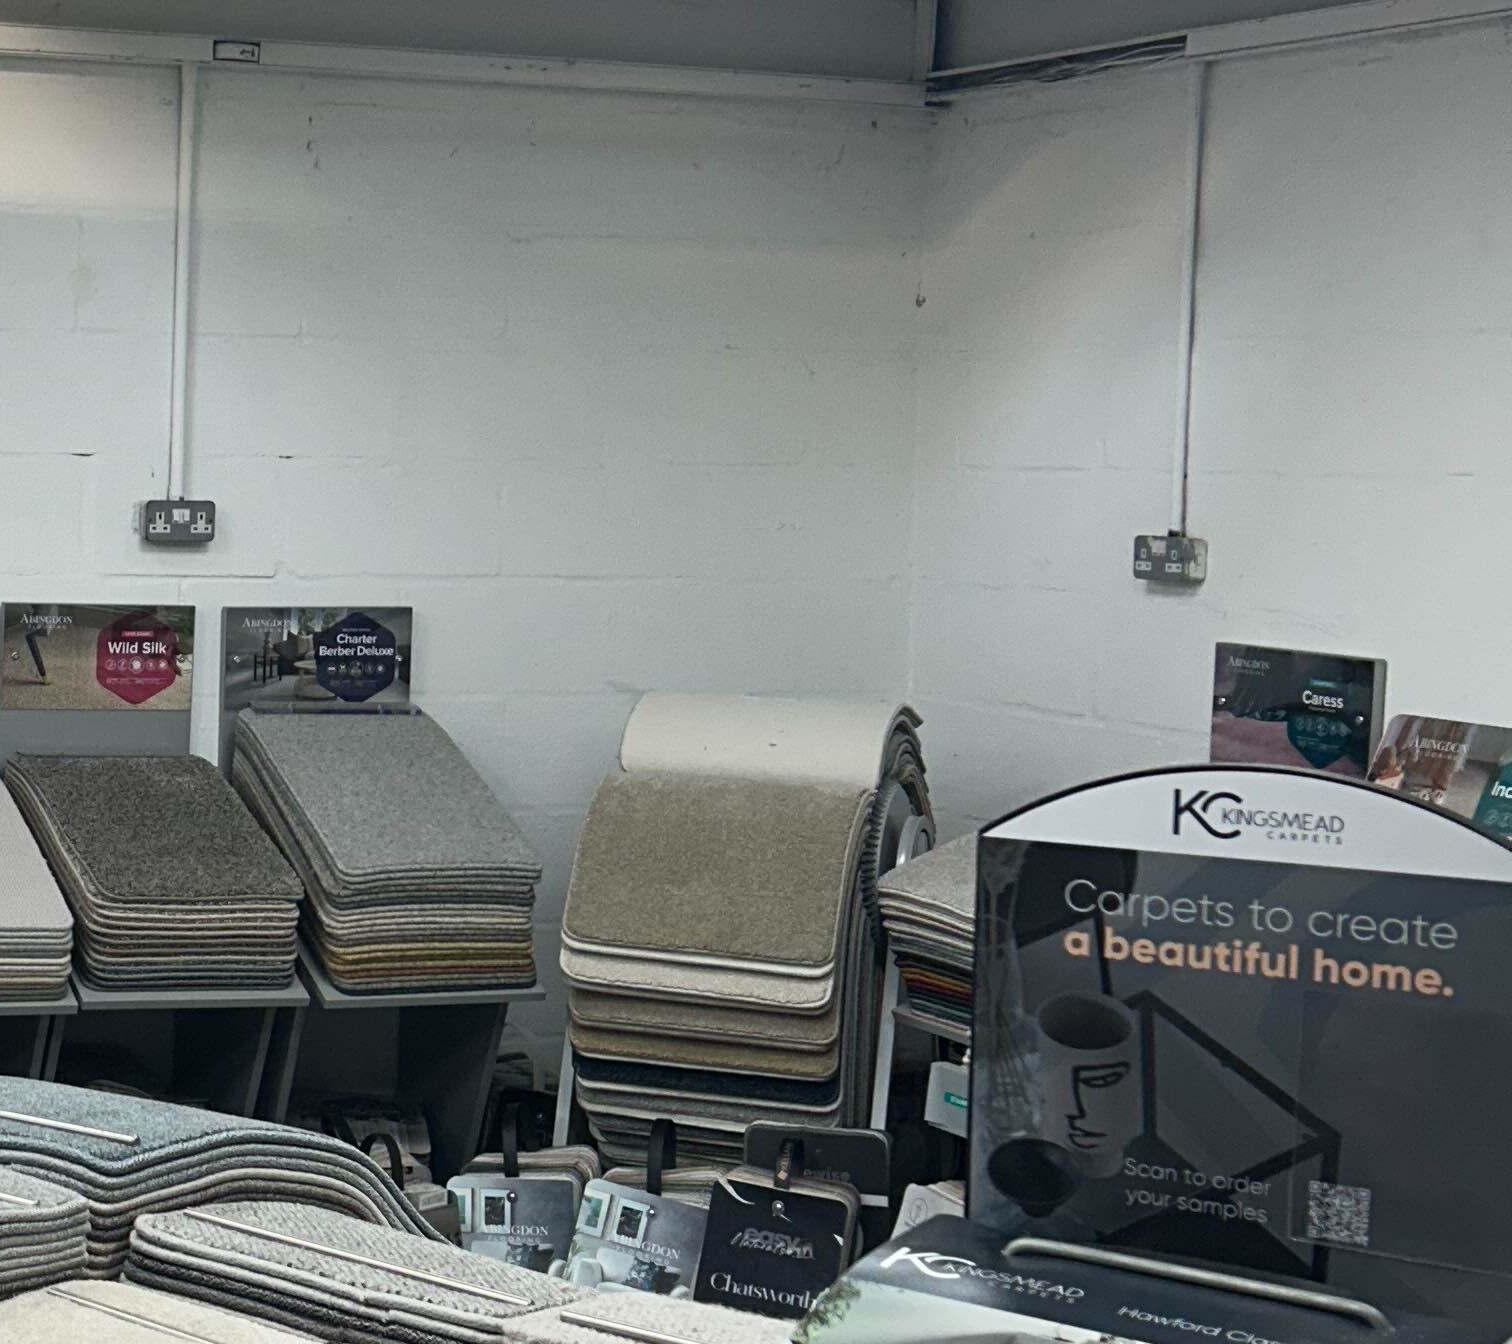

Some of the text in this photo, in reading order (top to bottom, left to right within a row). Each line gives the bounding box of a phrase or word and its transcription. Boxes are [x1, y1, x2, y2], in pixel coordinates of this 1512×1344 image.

[20, 613, 73, 625] ABINGDON
[108, 641, 167, 654] Wild Silk
[319, 645, 394, 657] Berber Deluxe
[336, 633, 377, 644] Charter
[1227, 655, 1271, 670] ABINGDON
[1302, 689, 1344, 709] Caress
[1221, 807, 1345, 833] KINGSMEAD
[1266, 830, 1343, 845] CARPETS
[1064, 878, 1459, 950] Carpets to create
[1064, 926, 1455, 998] a beautiful home.
[1124, 1156, 1272, 1196] Scan to order
[1124, 1188, 1269, 1224] your samples
[710, 1271, 816, 1311] Chatsworth
[943, 1262, 1086, 1299] KINGSMEAD
[1117, 1305, 1223, 1338] Hawford
